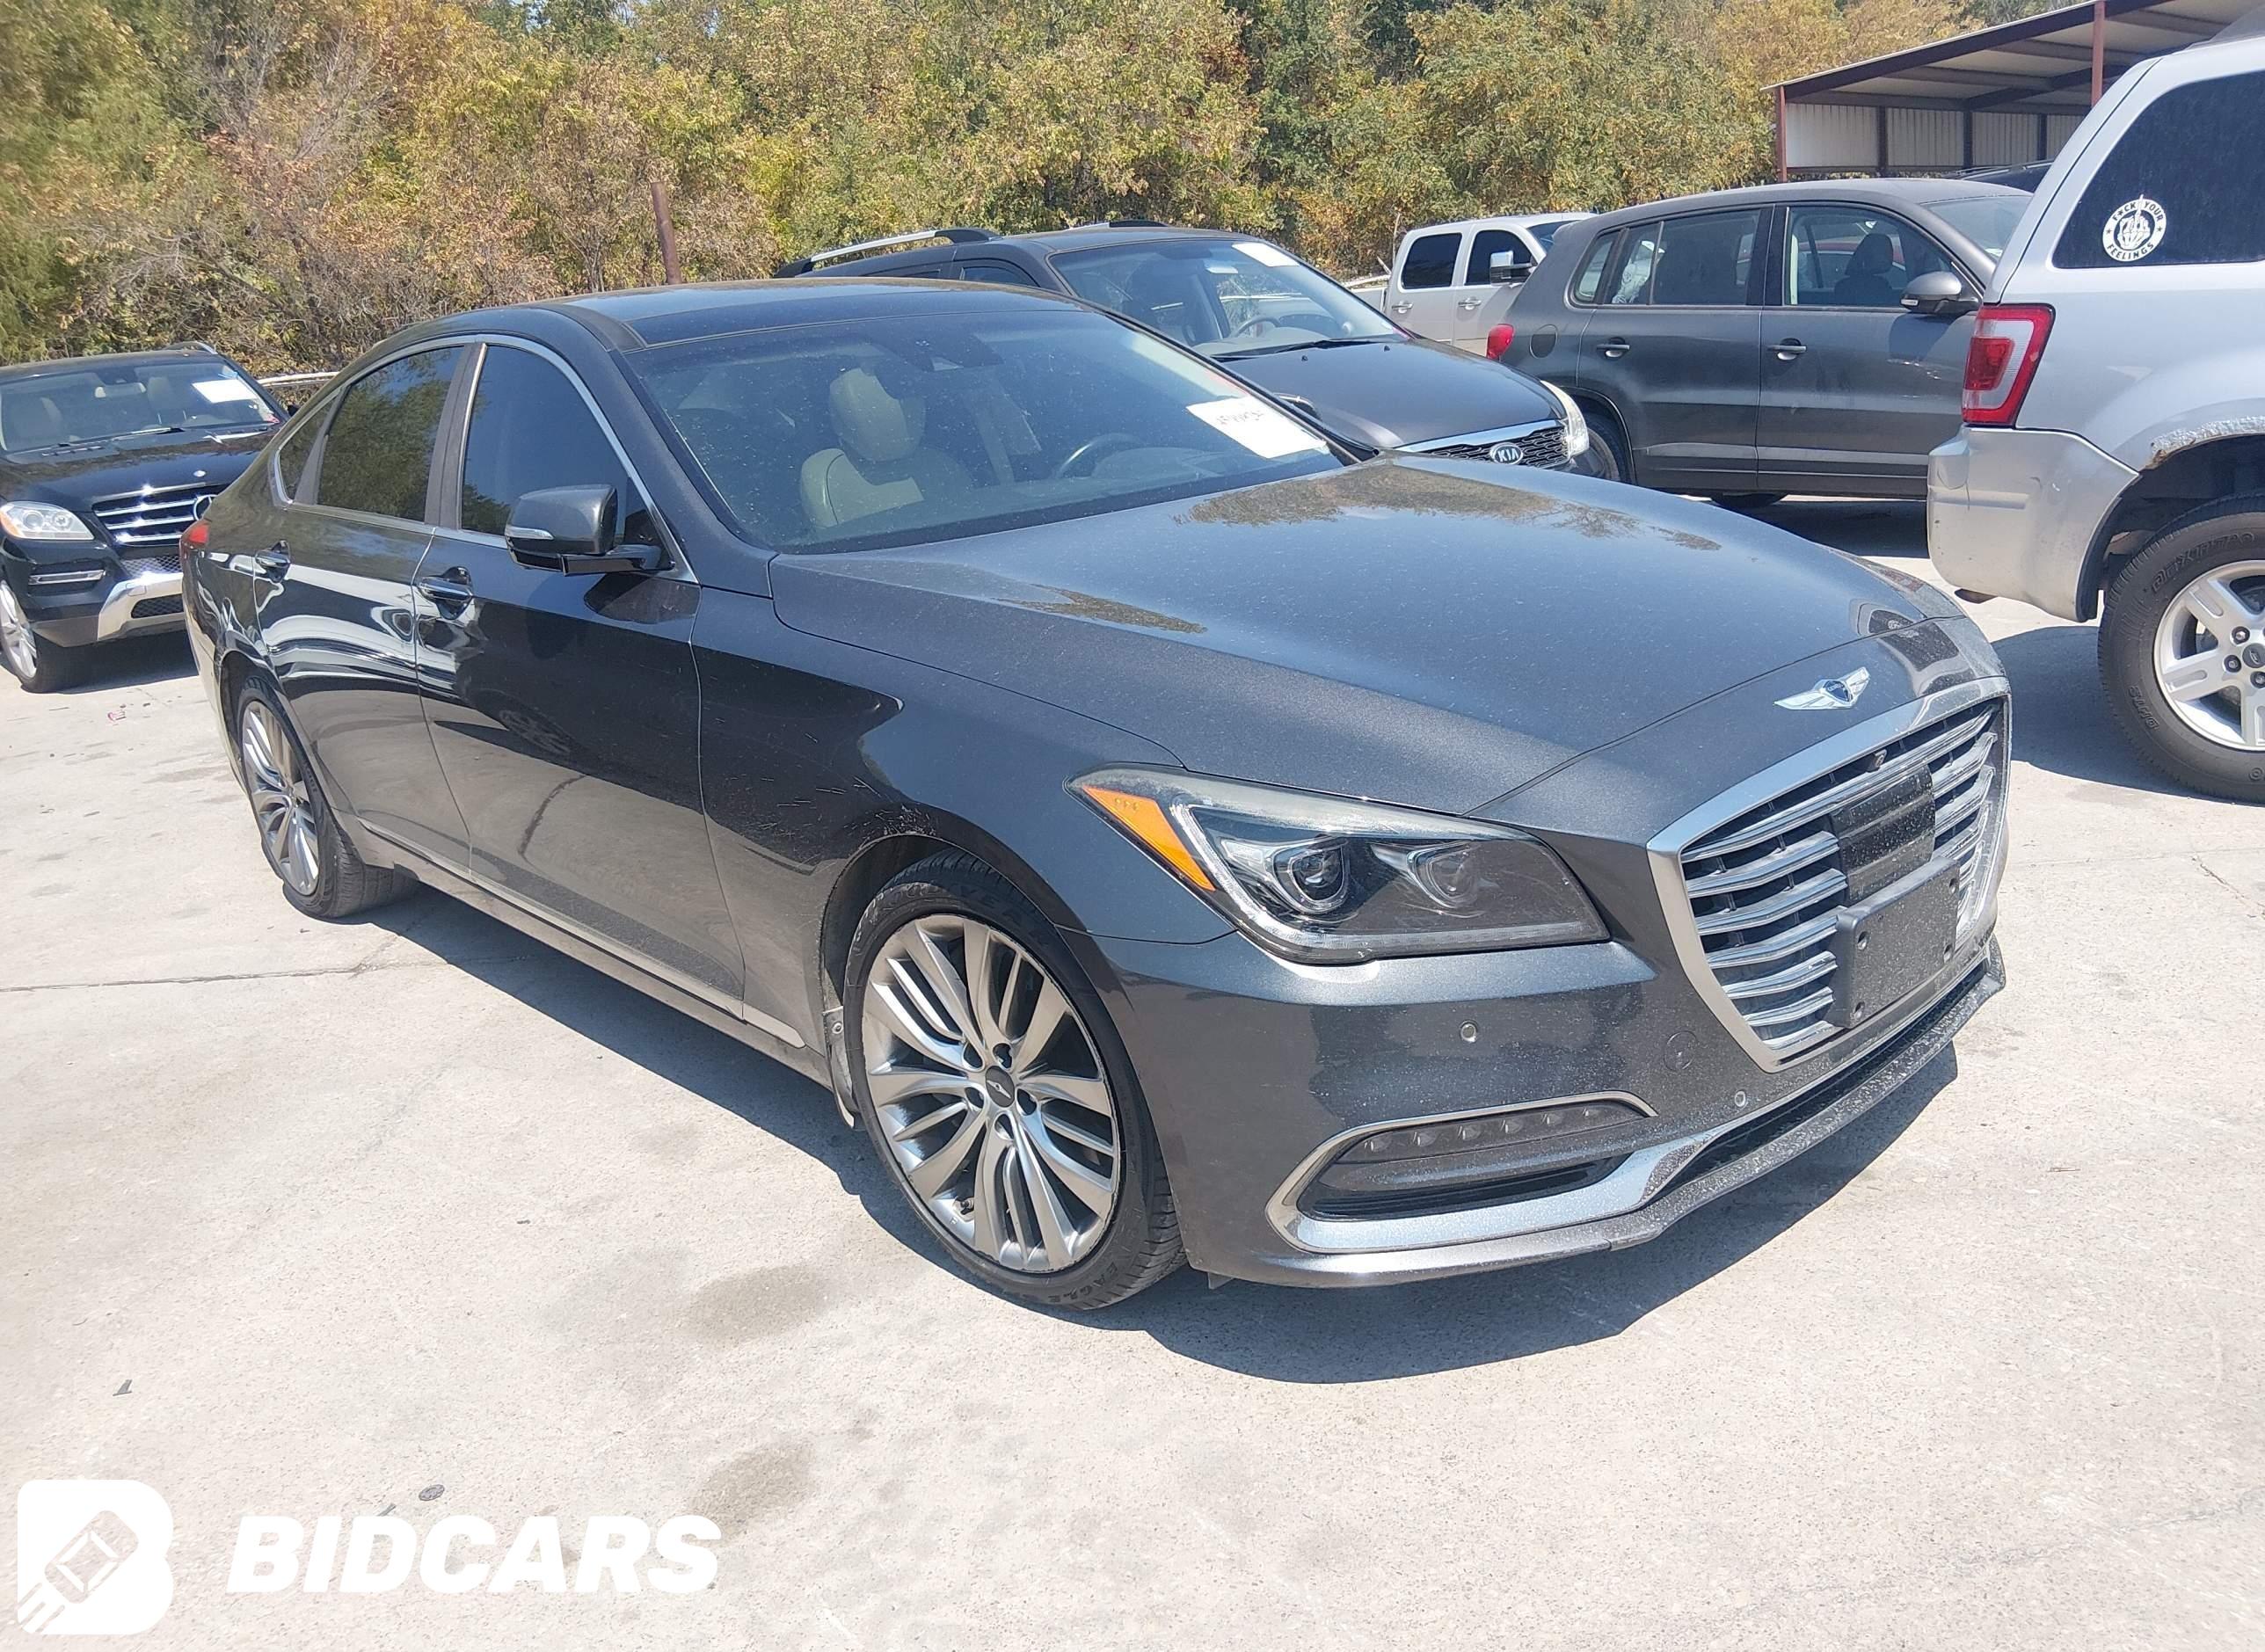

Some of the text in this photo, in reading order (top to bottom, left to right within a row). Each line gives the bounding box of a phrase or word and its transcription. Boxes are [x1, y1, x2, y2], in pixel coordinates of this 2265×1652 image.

[2144, 200, 2164, 222] YOUR
[2107, 242, 2154, 260] FEELINGS
[1497, 449, 1519, 462] KIA
[1047, 1261, 1118, 1303] EAGLE
